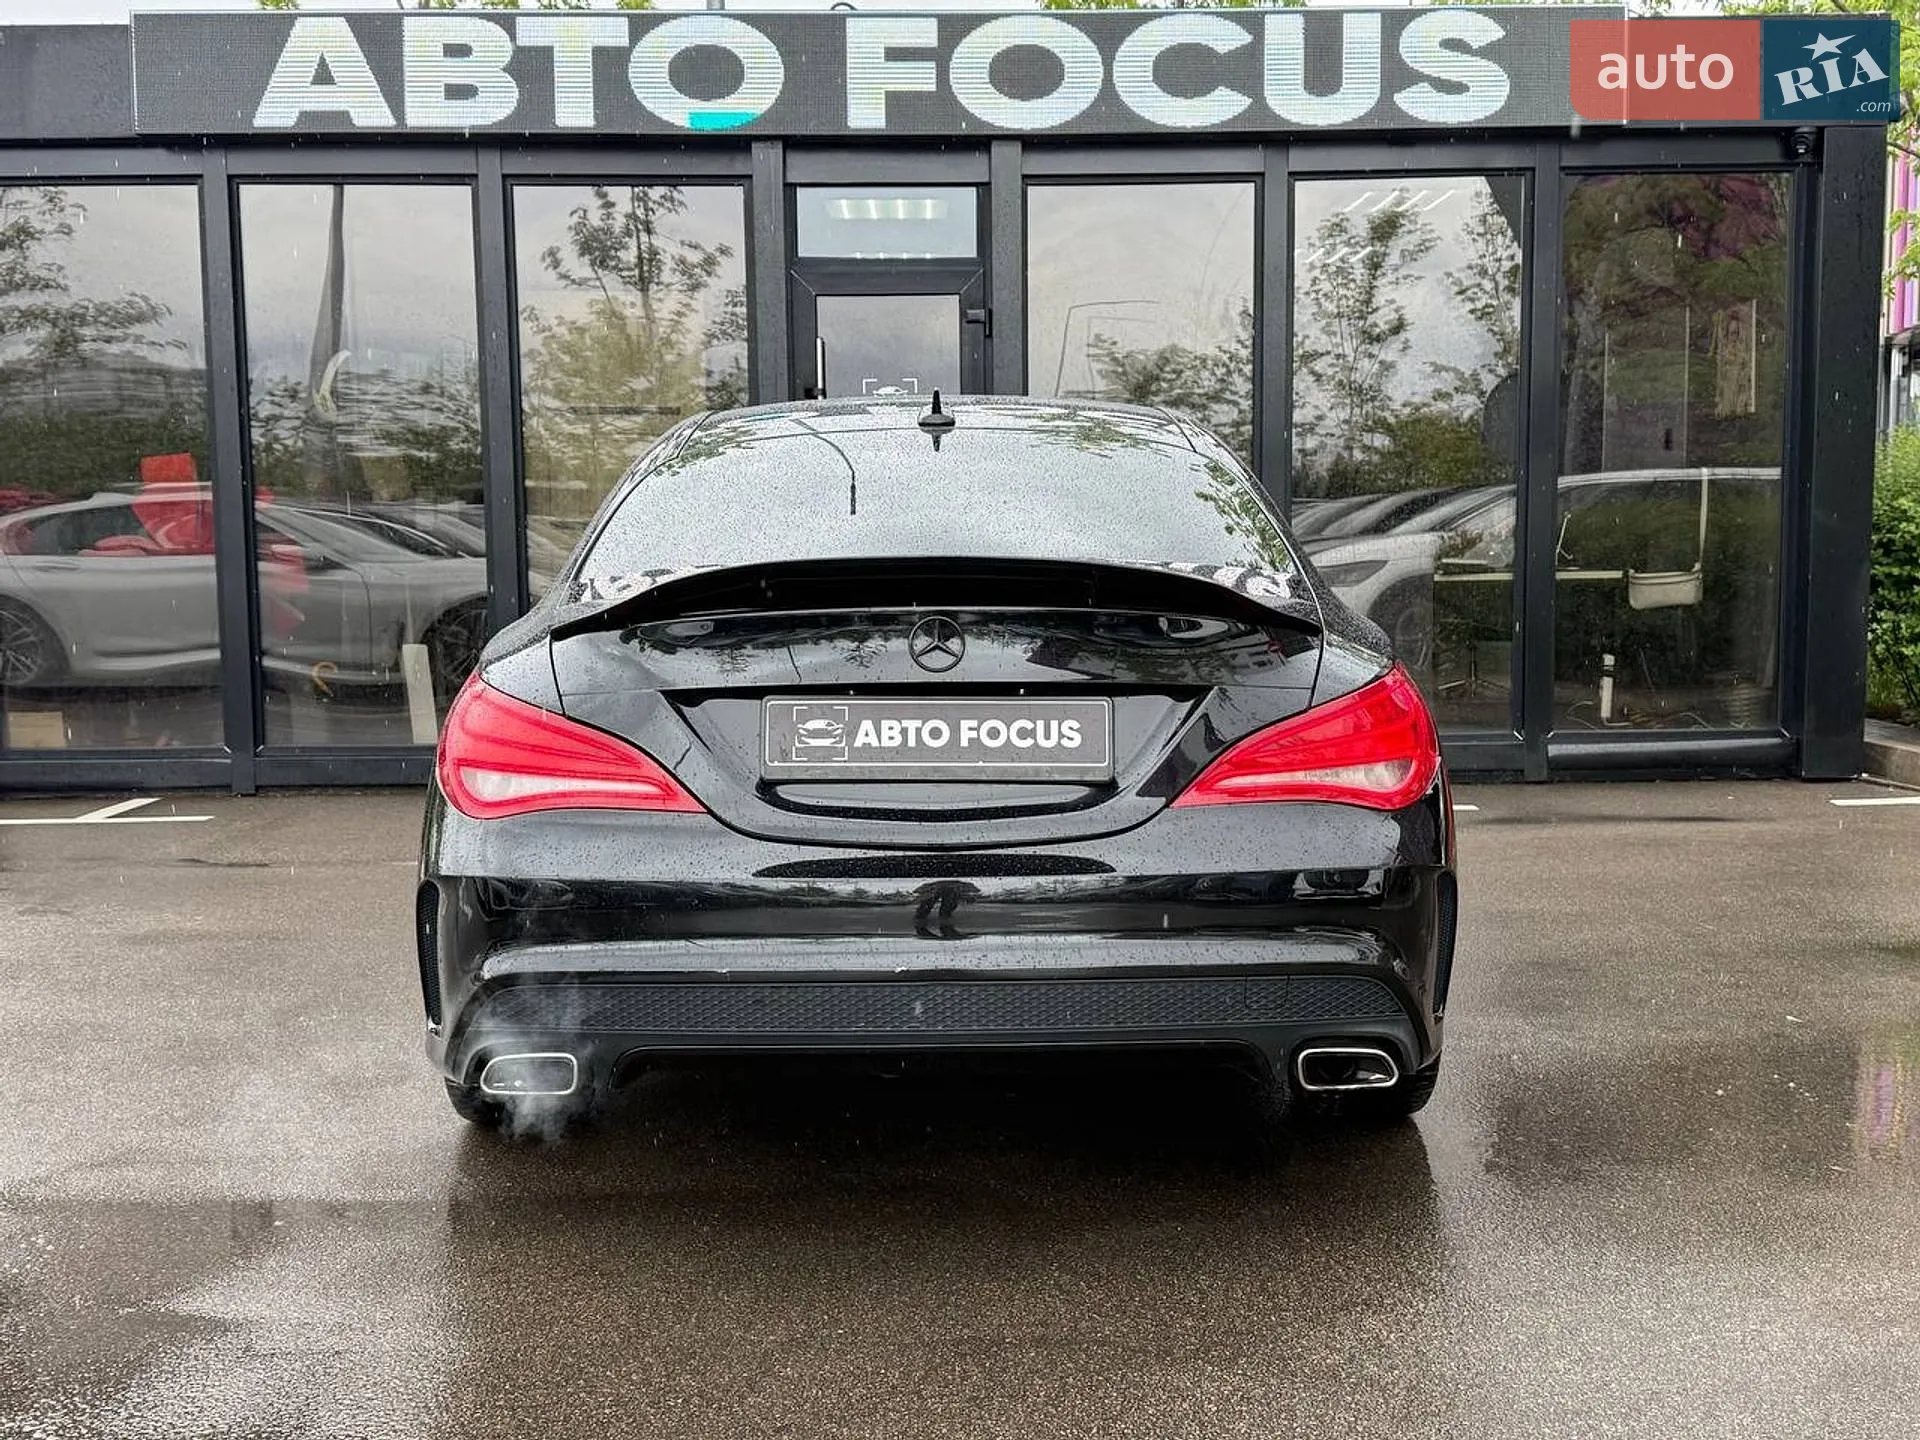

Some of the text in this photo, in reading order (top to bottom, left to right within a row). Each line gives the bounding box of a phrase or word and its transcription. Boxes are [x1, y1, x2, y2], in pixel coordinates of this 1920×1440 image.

[252, 9, 1510, 131] АВТО FOCUS
[853, 719, 1082, 748] АВТО FOCUS
